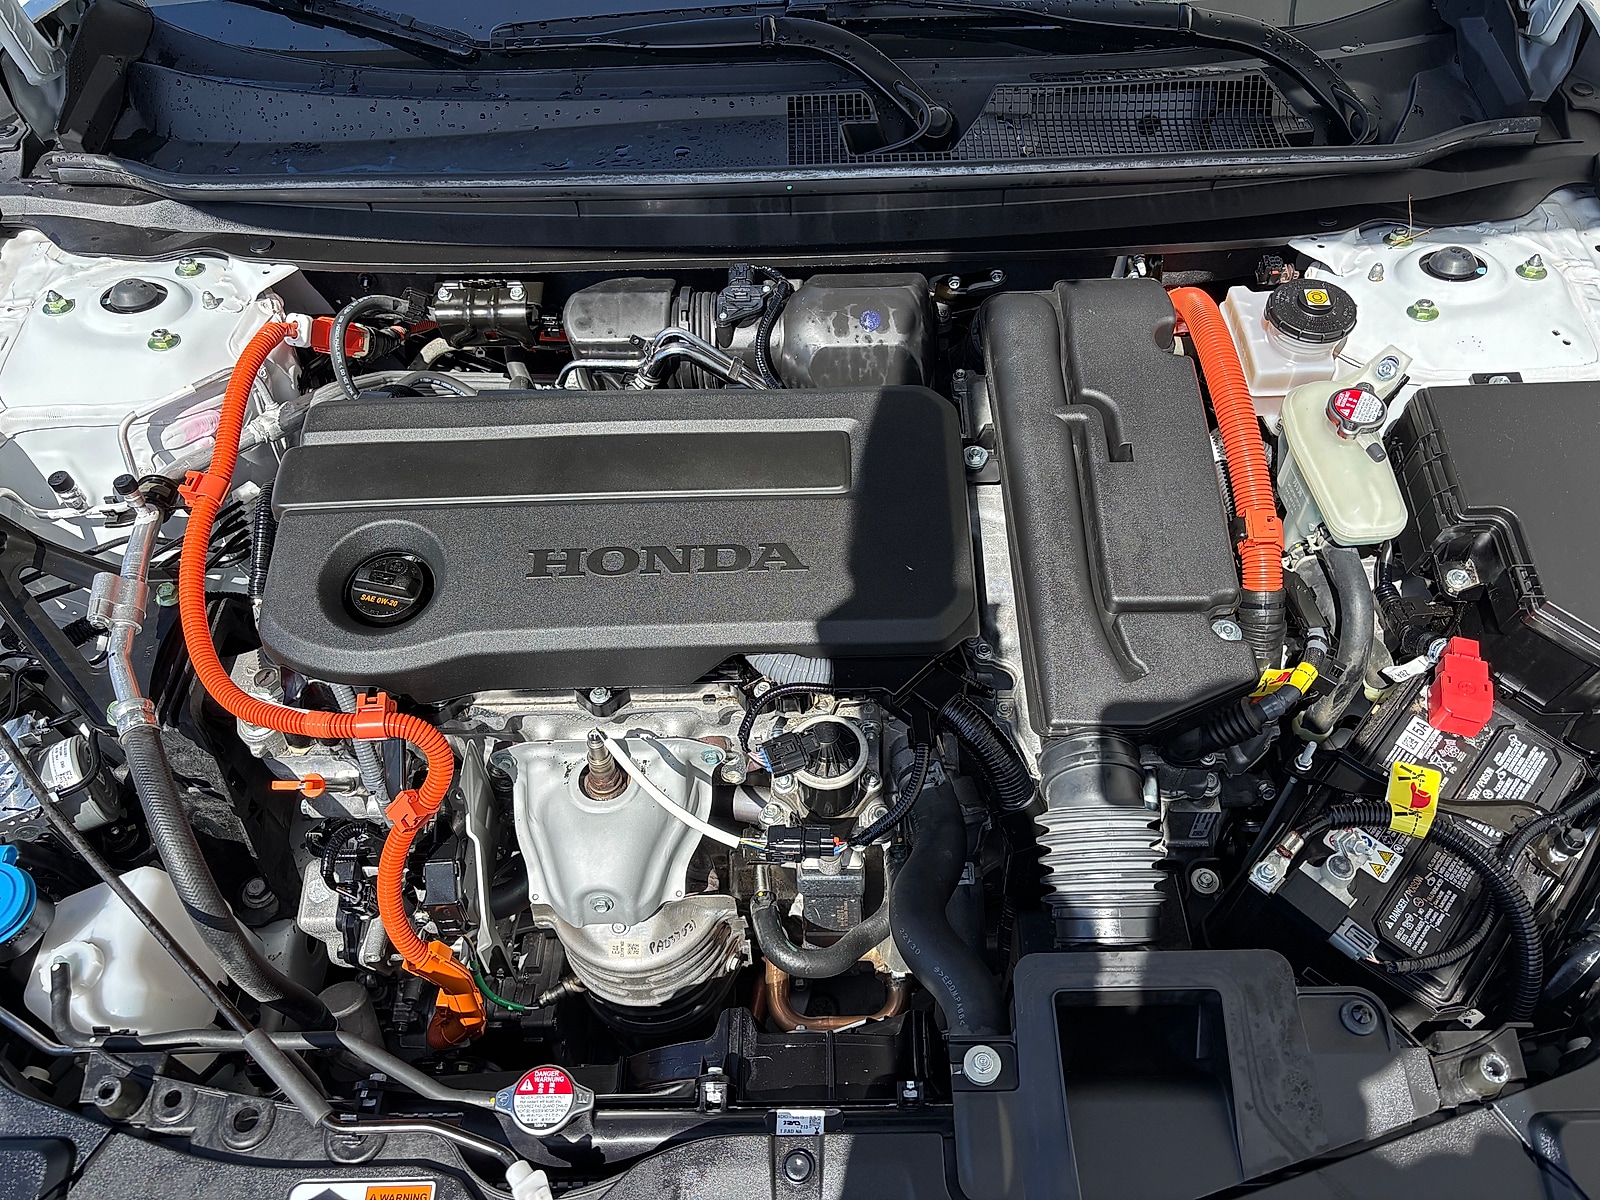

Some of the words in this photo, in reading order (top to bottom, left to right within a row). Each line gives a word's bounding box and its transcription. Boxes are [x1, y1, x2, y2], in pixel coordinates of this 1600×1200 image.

[526, 542, 809, 580] HONDA
[360, 594, 374, 602] SAE
[376, 597, 398, 607] 0W-20
[1411, 719, 1429, 737] 5A
[1448, 764, 1458, 774] Pb
[1388, 874, 1424, 922] DANGER/POISON
[900, 928, 921, 955] 22Y30
